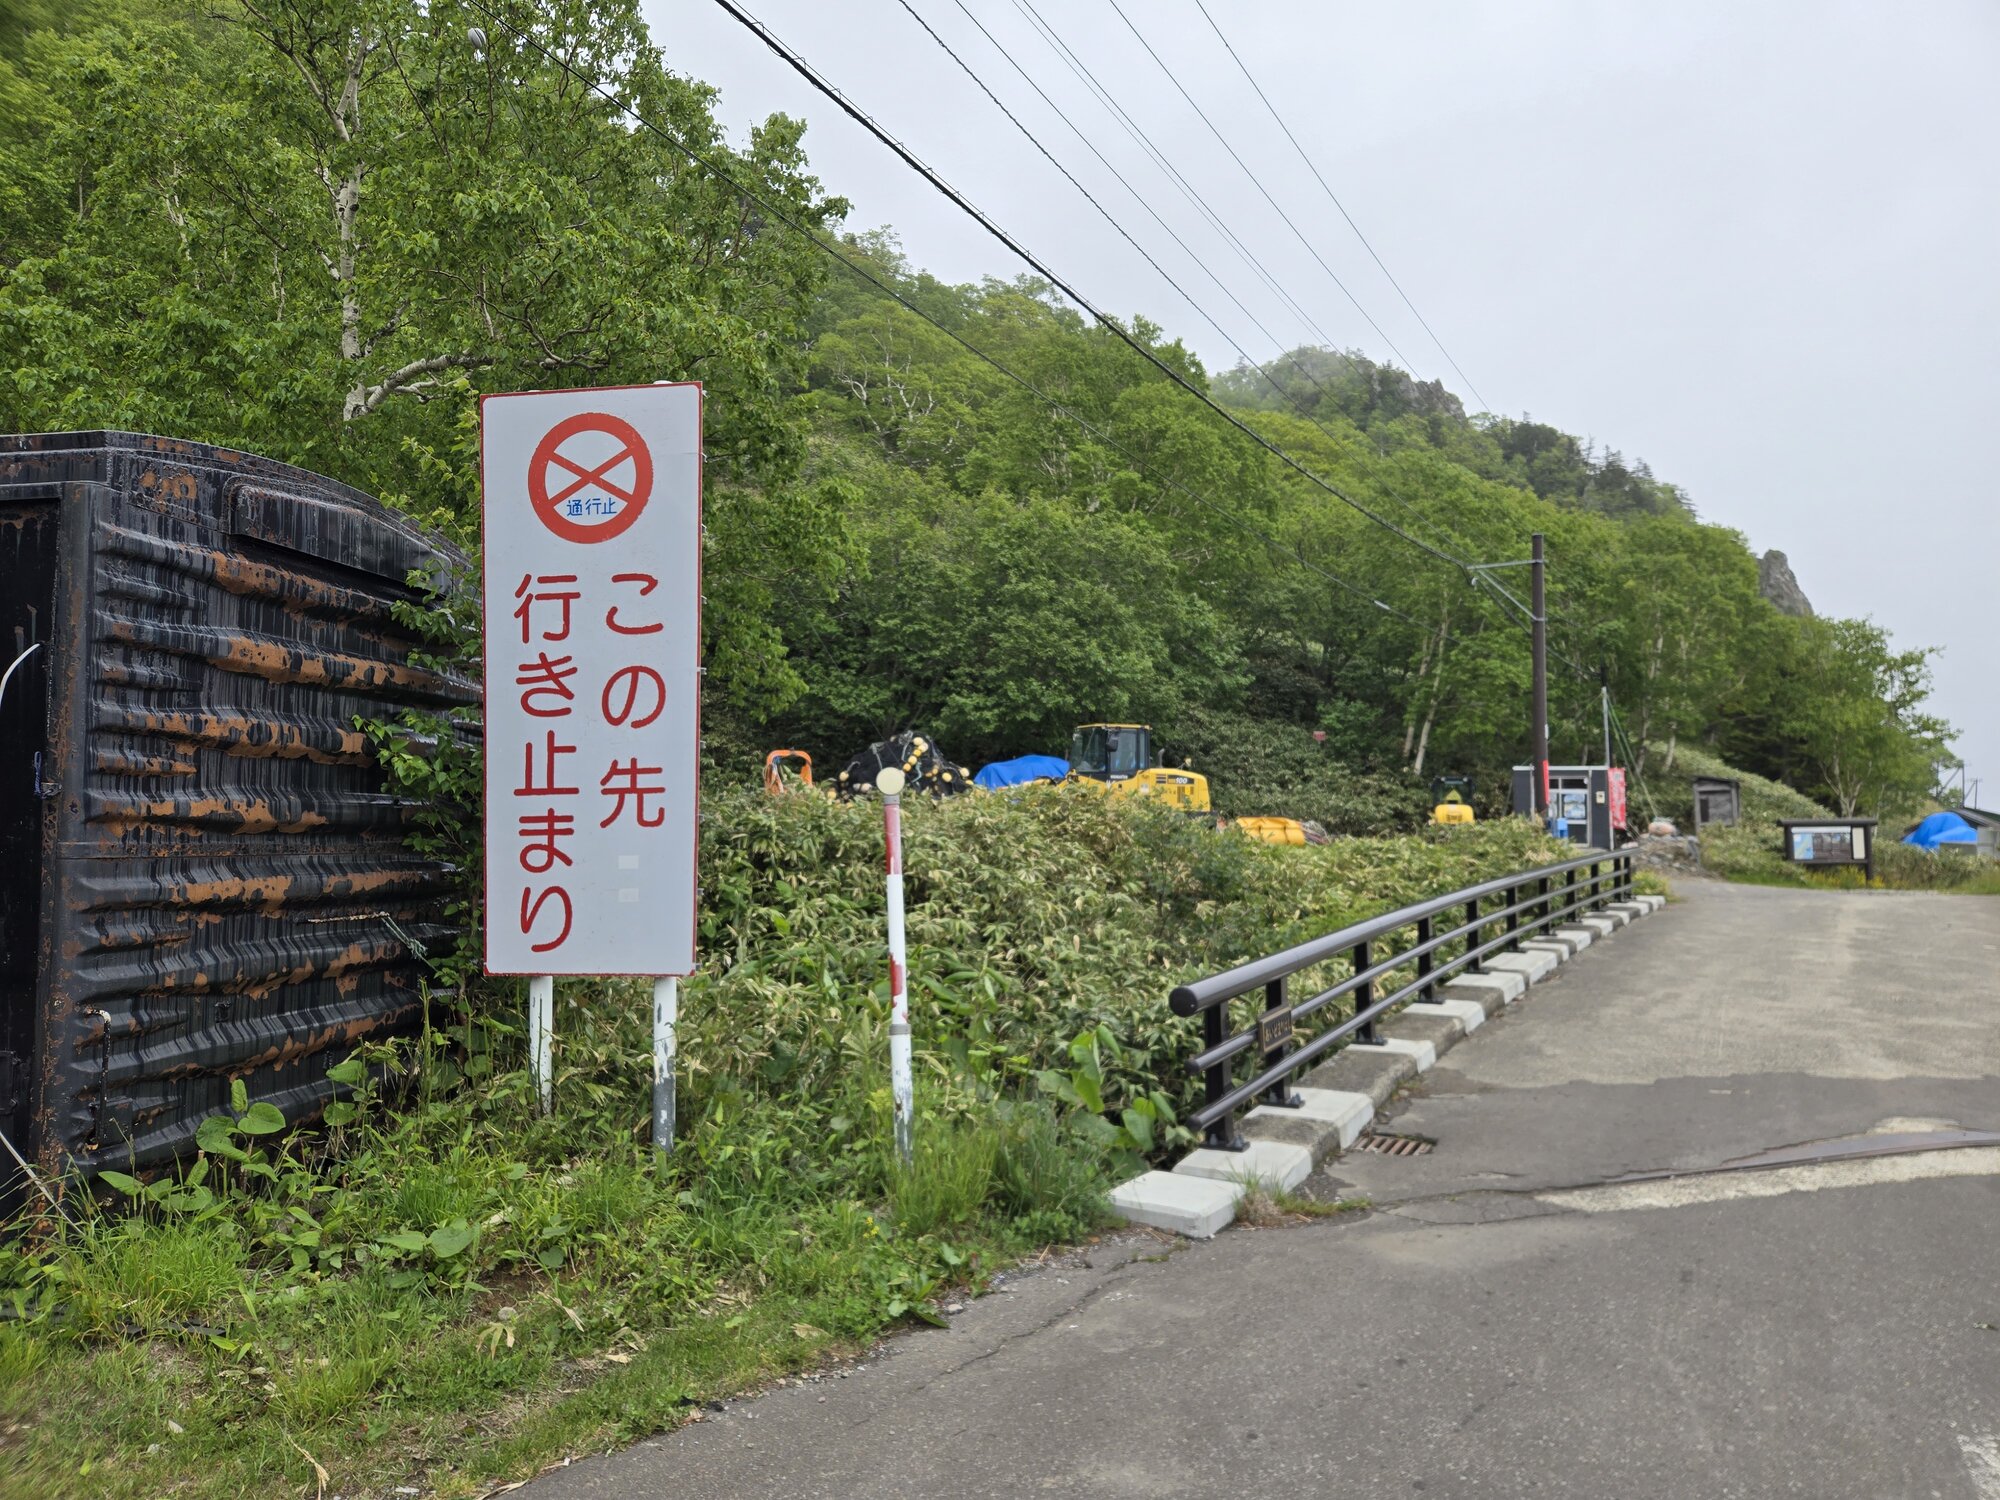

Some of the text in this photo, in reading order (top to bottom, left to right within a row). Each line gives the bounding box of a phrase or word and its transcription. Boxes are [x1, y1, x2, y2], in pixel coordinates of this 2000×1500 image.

[567, 497, 617, 517] 通行止
[514, 574, 581, 953] 行き止まり
[600, 573, 666, 828] この先
